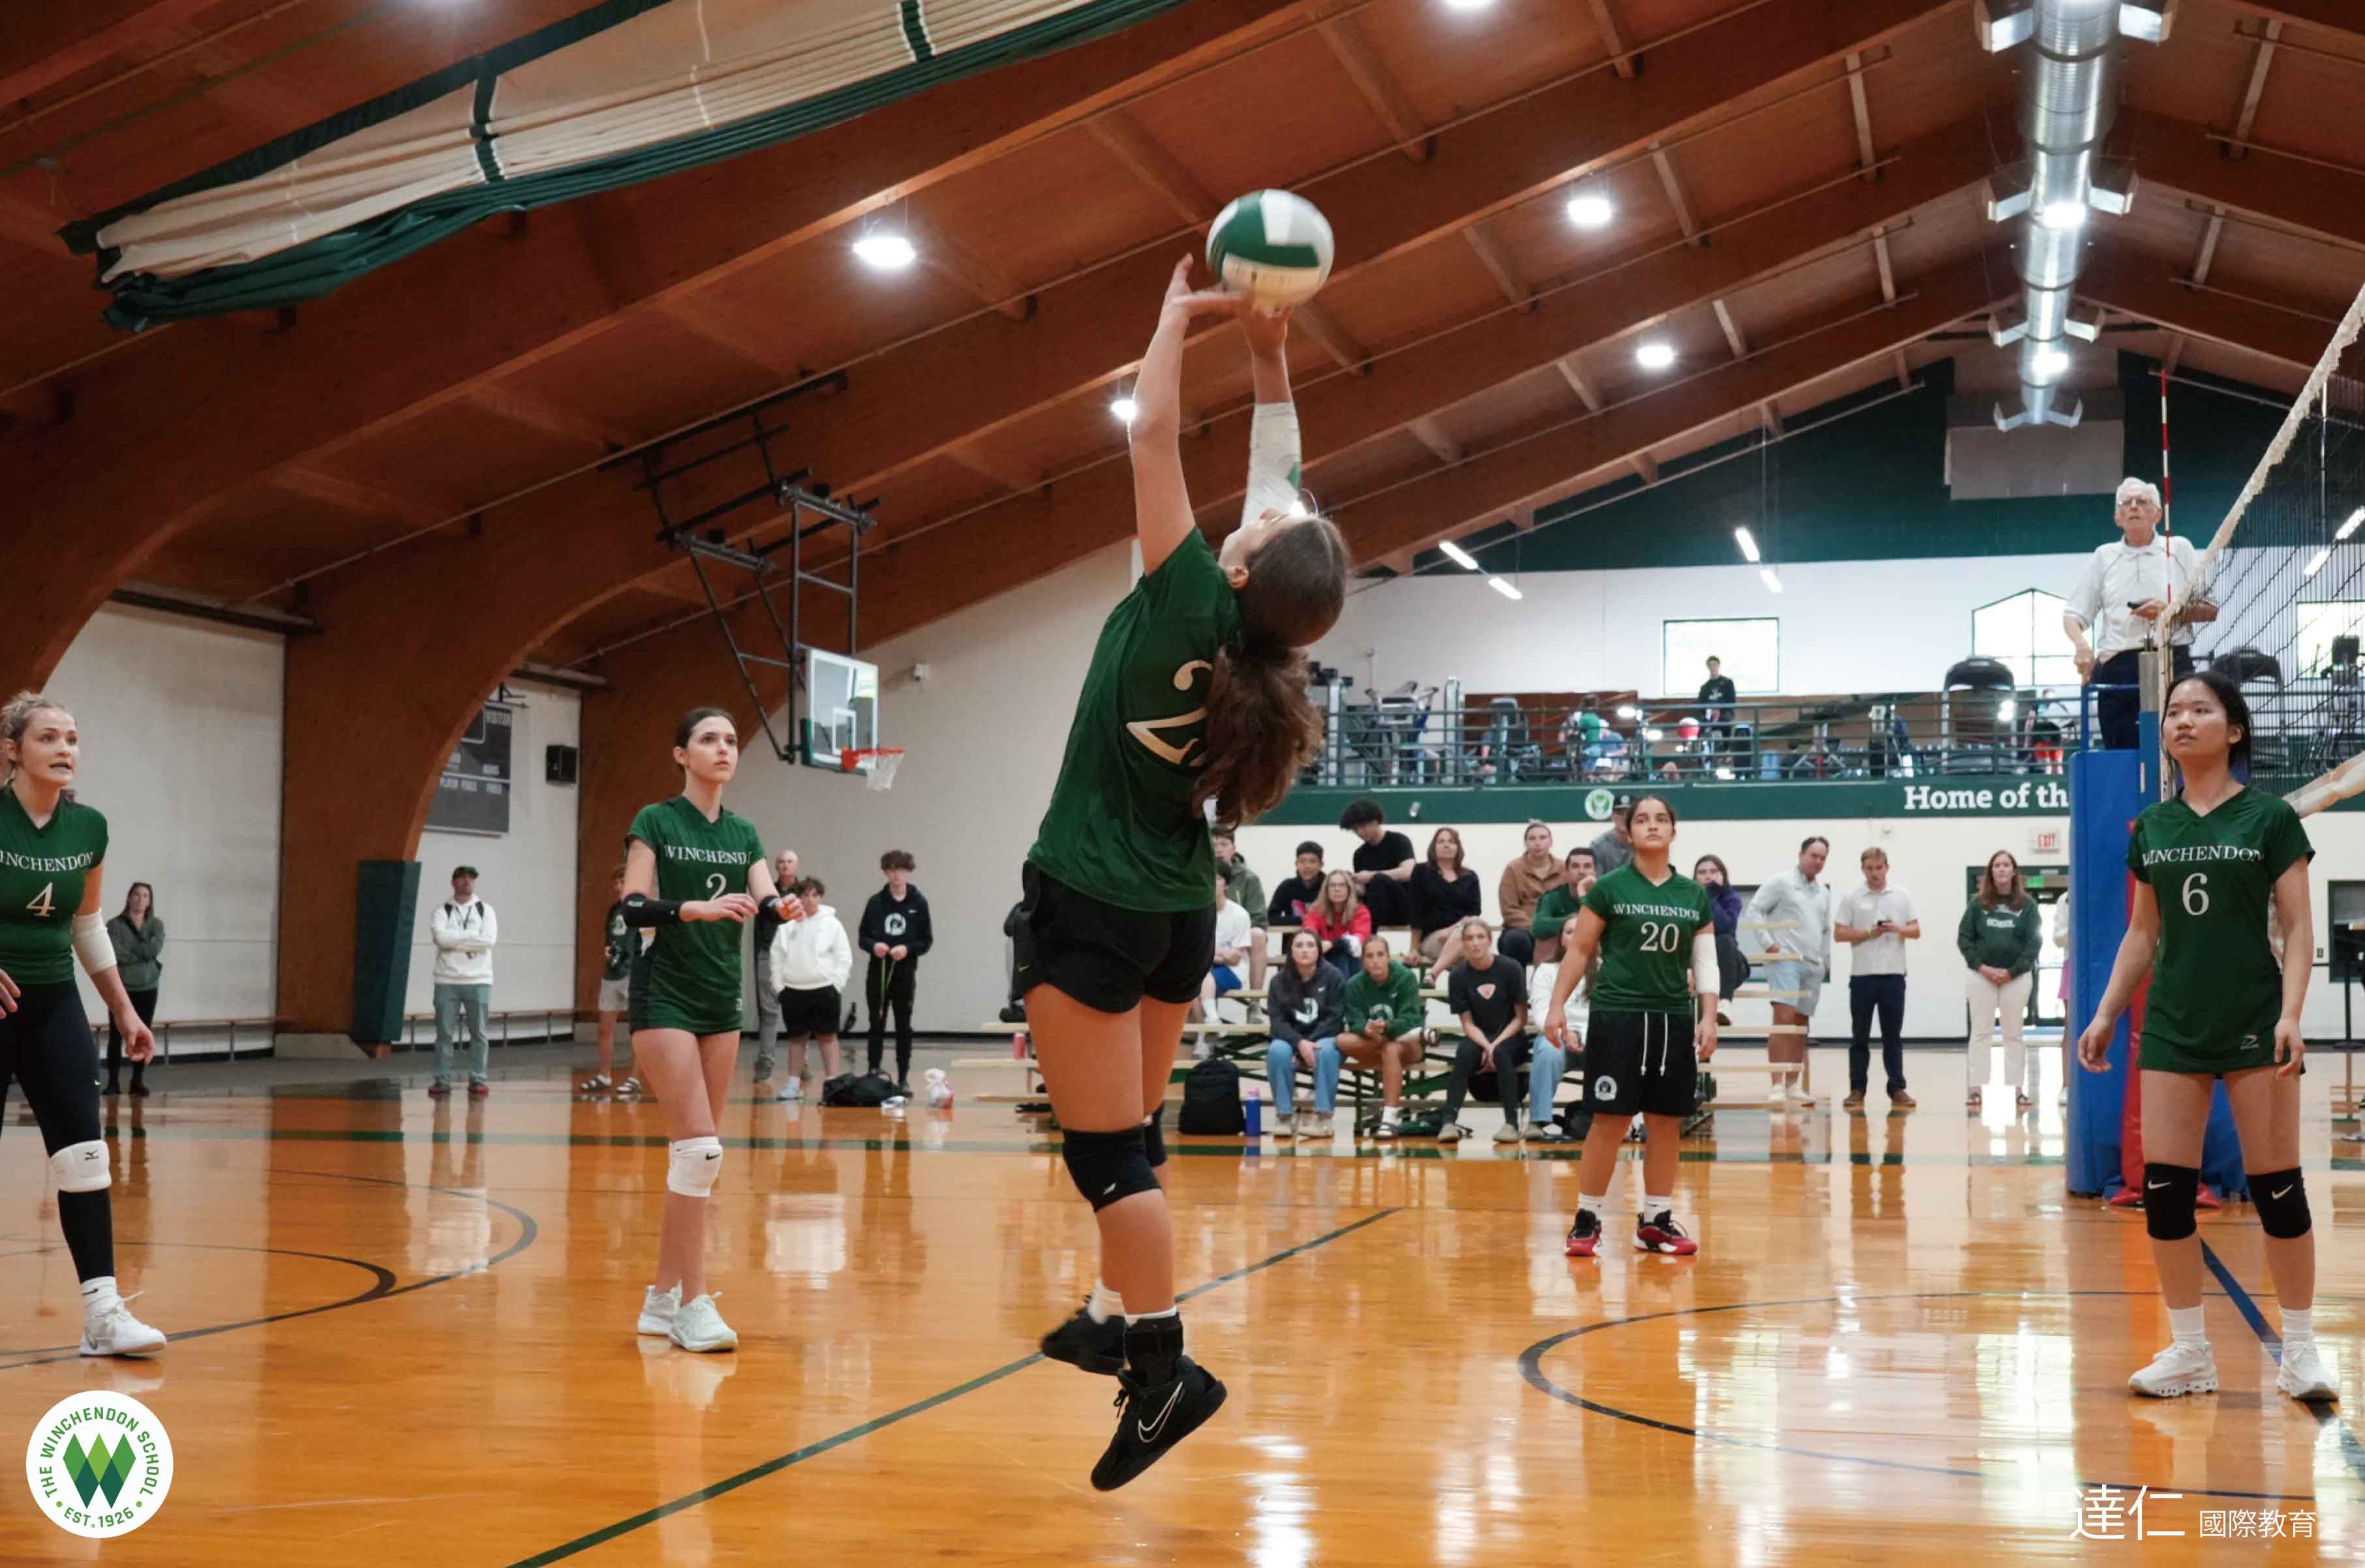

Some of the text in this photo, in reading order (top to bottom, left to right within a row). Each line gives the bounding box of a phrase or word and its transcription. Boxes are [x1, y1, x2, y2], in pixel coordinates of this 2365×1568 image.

[1904, 782, 2069, 809] Home of th
[26, 882, 56, 917] 4
[706, 873, 727, 903] 2
[2182, 873, 2210, 916] 6
[1640, 922, 1679, 953] 20
